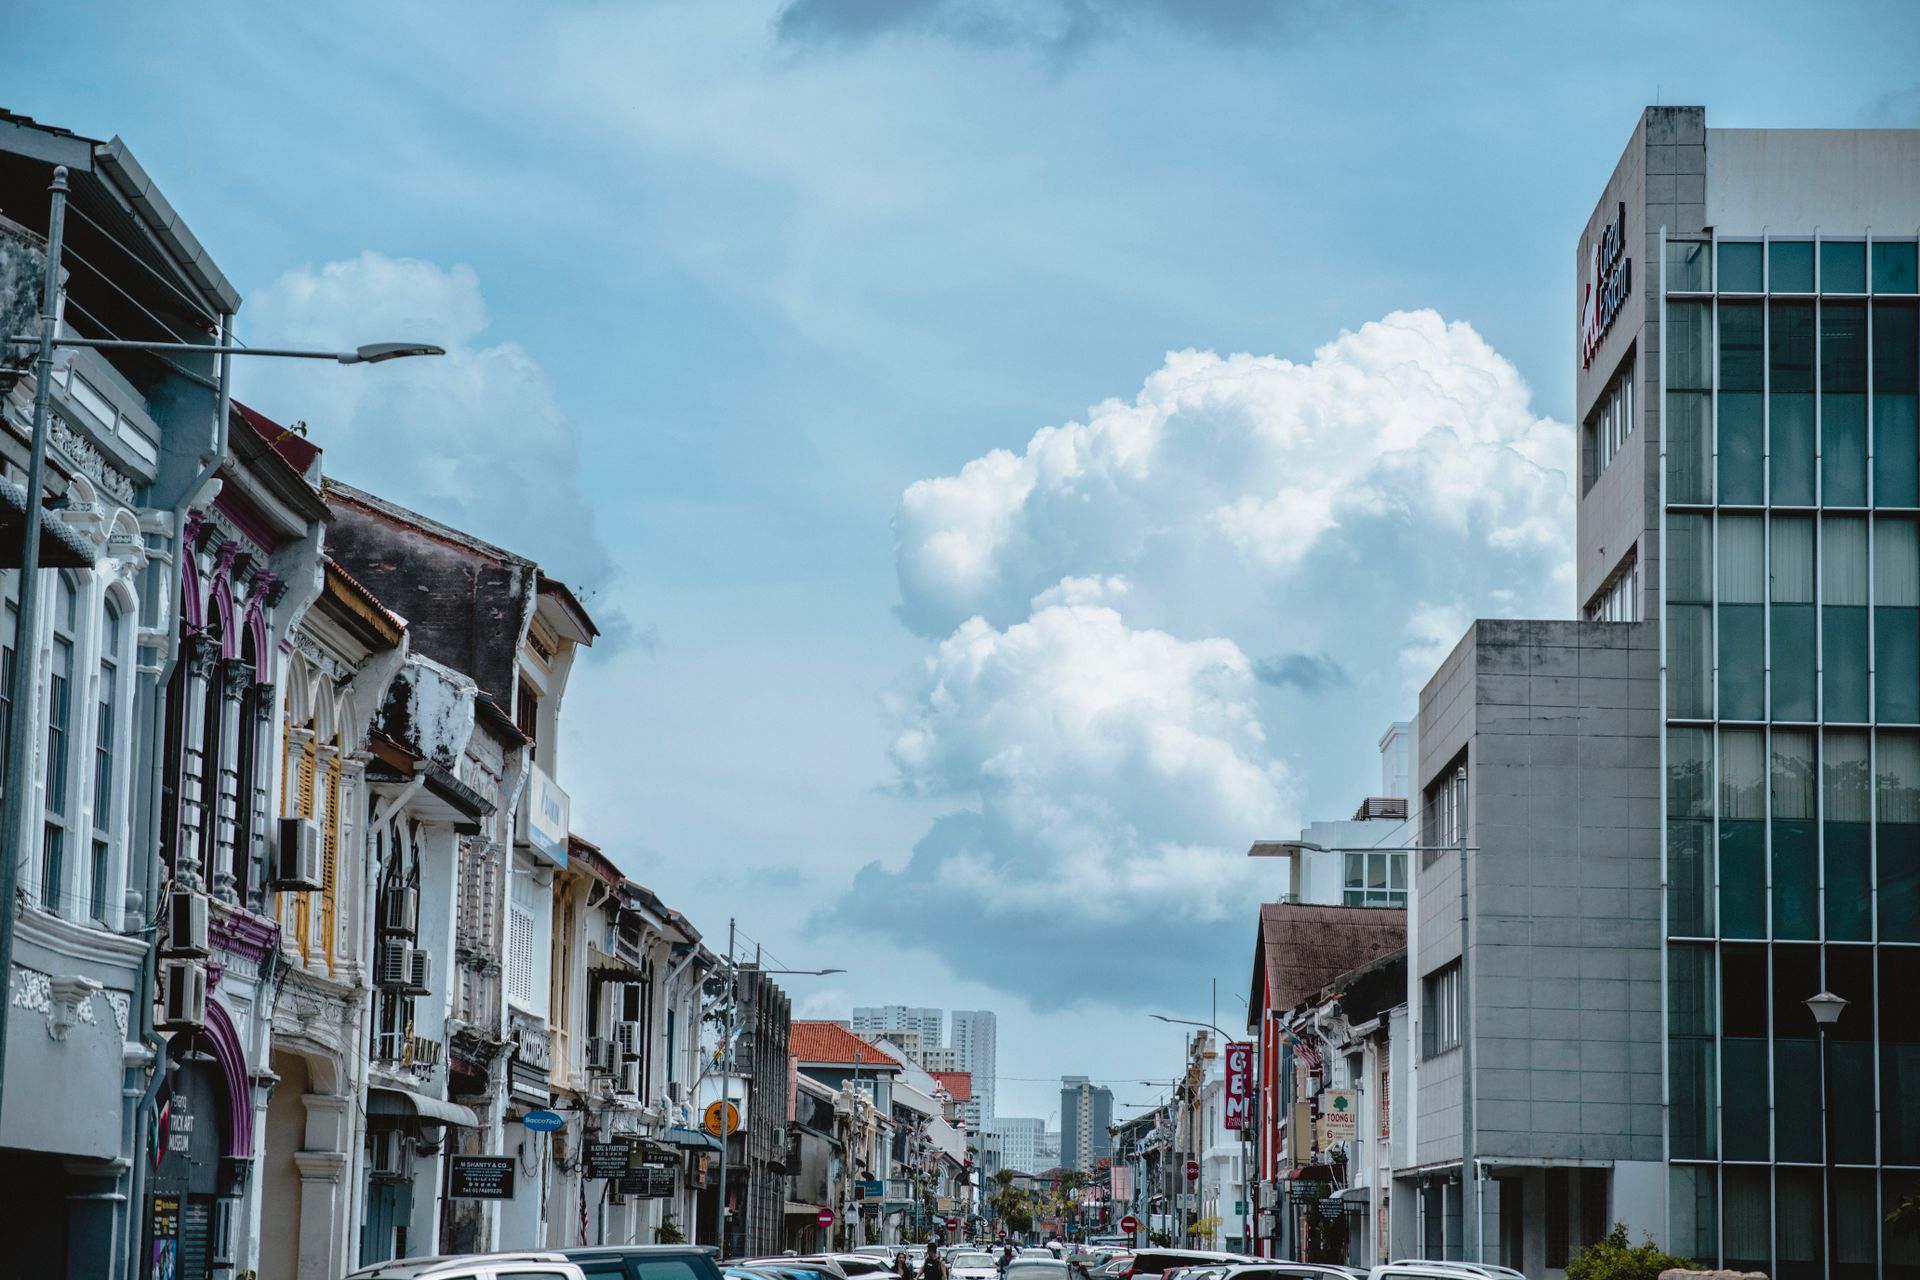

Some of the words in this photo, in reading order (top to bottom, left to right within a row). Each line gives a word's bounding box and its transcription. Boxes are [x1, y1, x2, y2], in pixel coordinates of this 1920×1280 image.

[183, 1115, 194, 1132] ART
[1327, 1113, 1348, 1123] TOONG
[1350, 1114, 1355, 1123] LI
[1327, 1130, 1333, 1138] 6
[168, 1134, 189, 1151] MUSEUM
